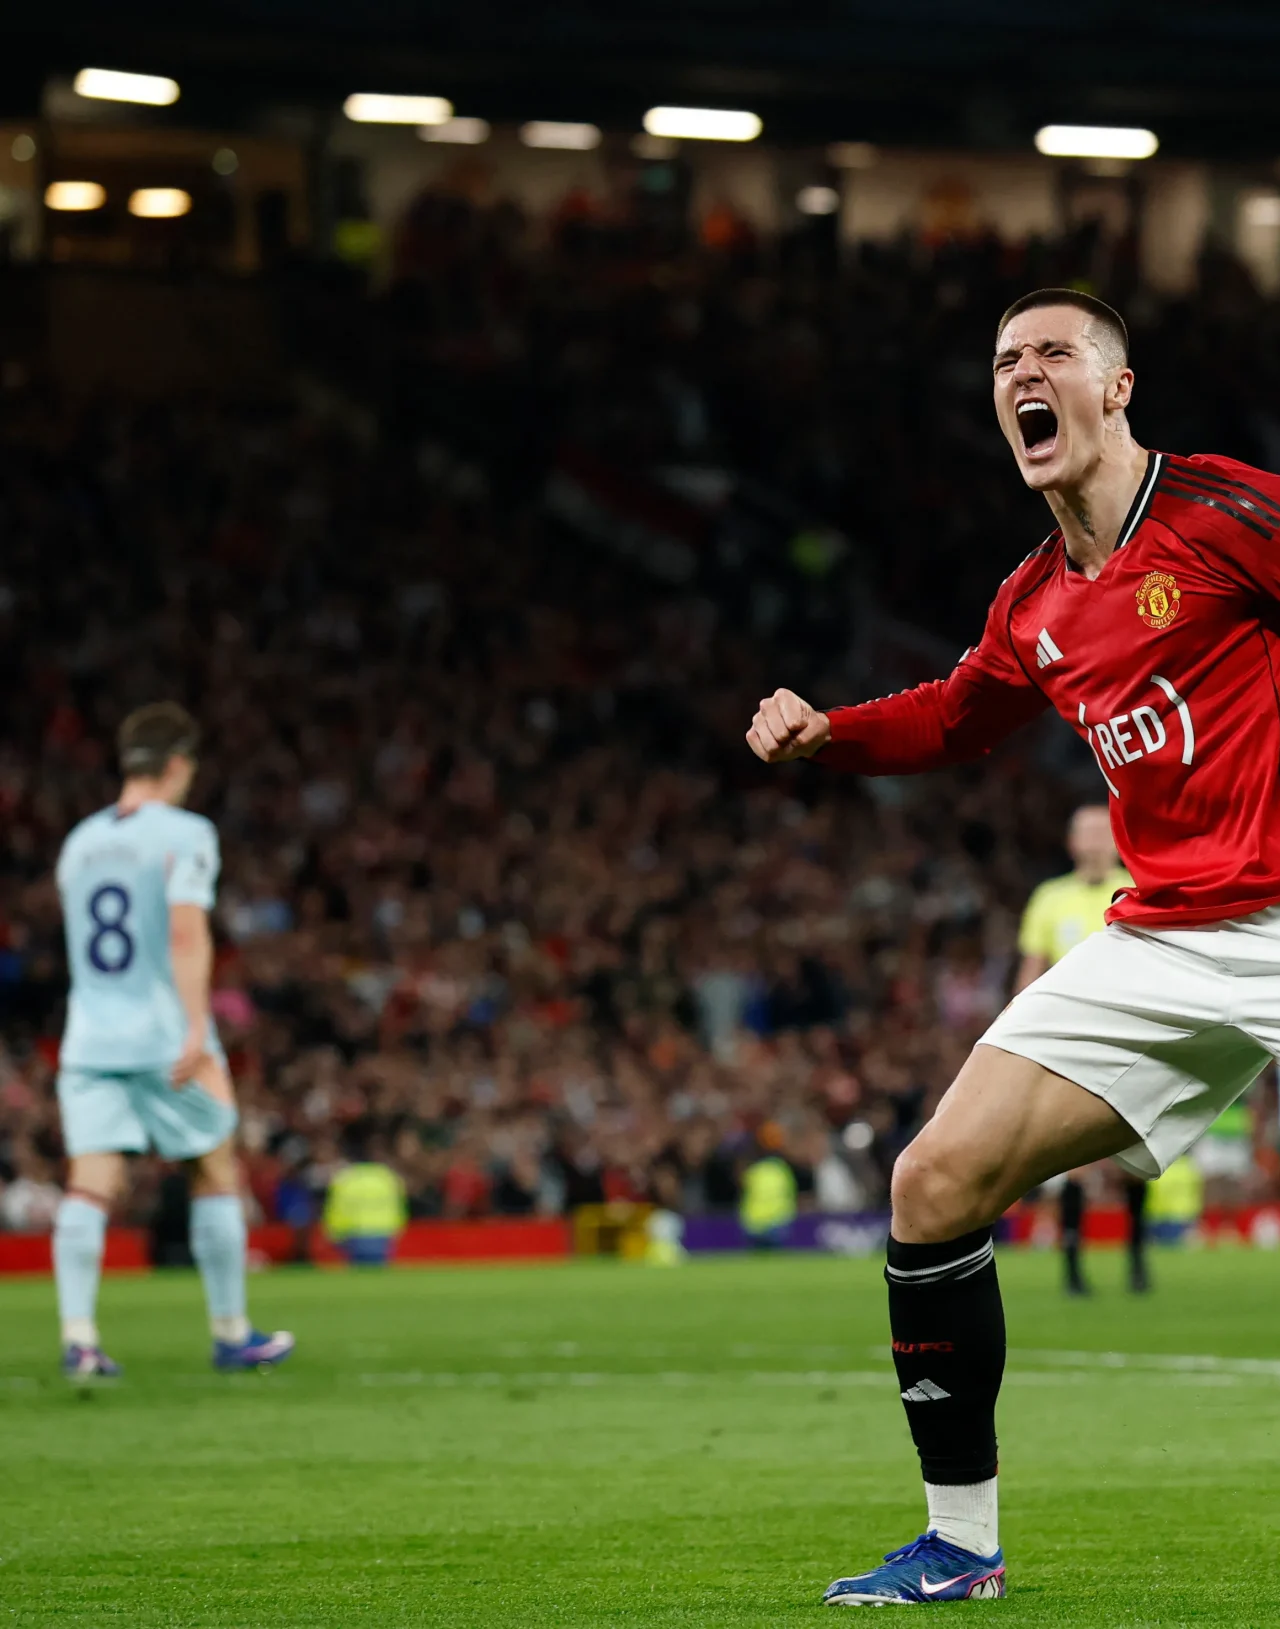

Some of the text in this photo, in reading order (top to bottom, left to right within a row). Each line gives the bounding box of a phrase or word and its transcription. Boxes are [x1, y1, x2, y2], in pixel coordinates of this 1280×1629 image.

[1139, 575, 1174, 601] MANCHESTER
[1150, 610, 1175, 626] UNITED
[87, 884, 134, 975] 8
